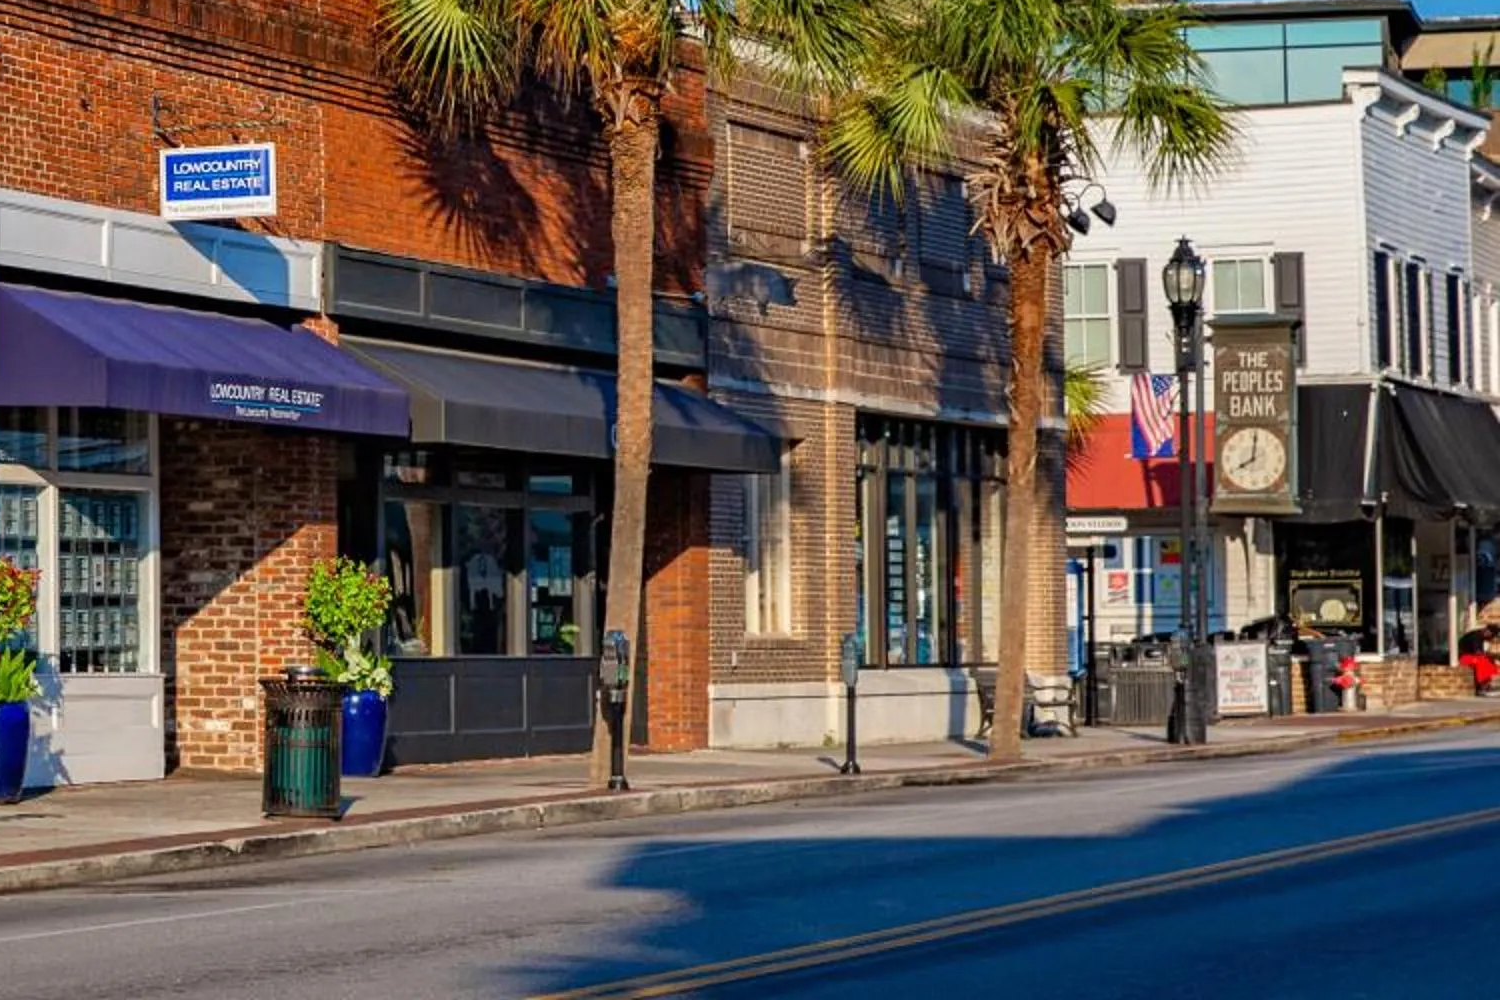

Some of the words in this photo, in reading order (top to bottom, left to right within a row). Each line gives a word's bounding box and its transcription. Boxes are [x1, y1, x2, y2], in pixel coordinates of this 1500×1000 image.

[173, 158, 261, 175] LOWCOUNTRY
[173, 179, 211, 193] REAL
[211, 176, 261, 191] ESTATE
[1237, 351, 1269, 369] THE
[1222, 370, 1284, 393] PEOPLES
[210, 383, 265, 400] LOWCOUNTRY
[268, 387, 291, 403] REAL
[1229, 394, 1277, 417] BANK
